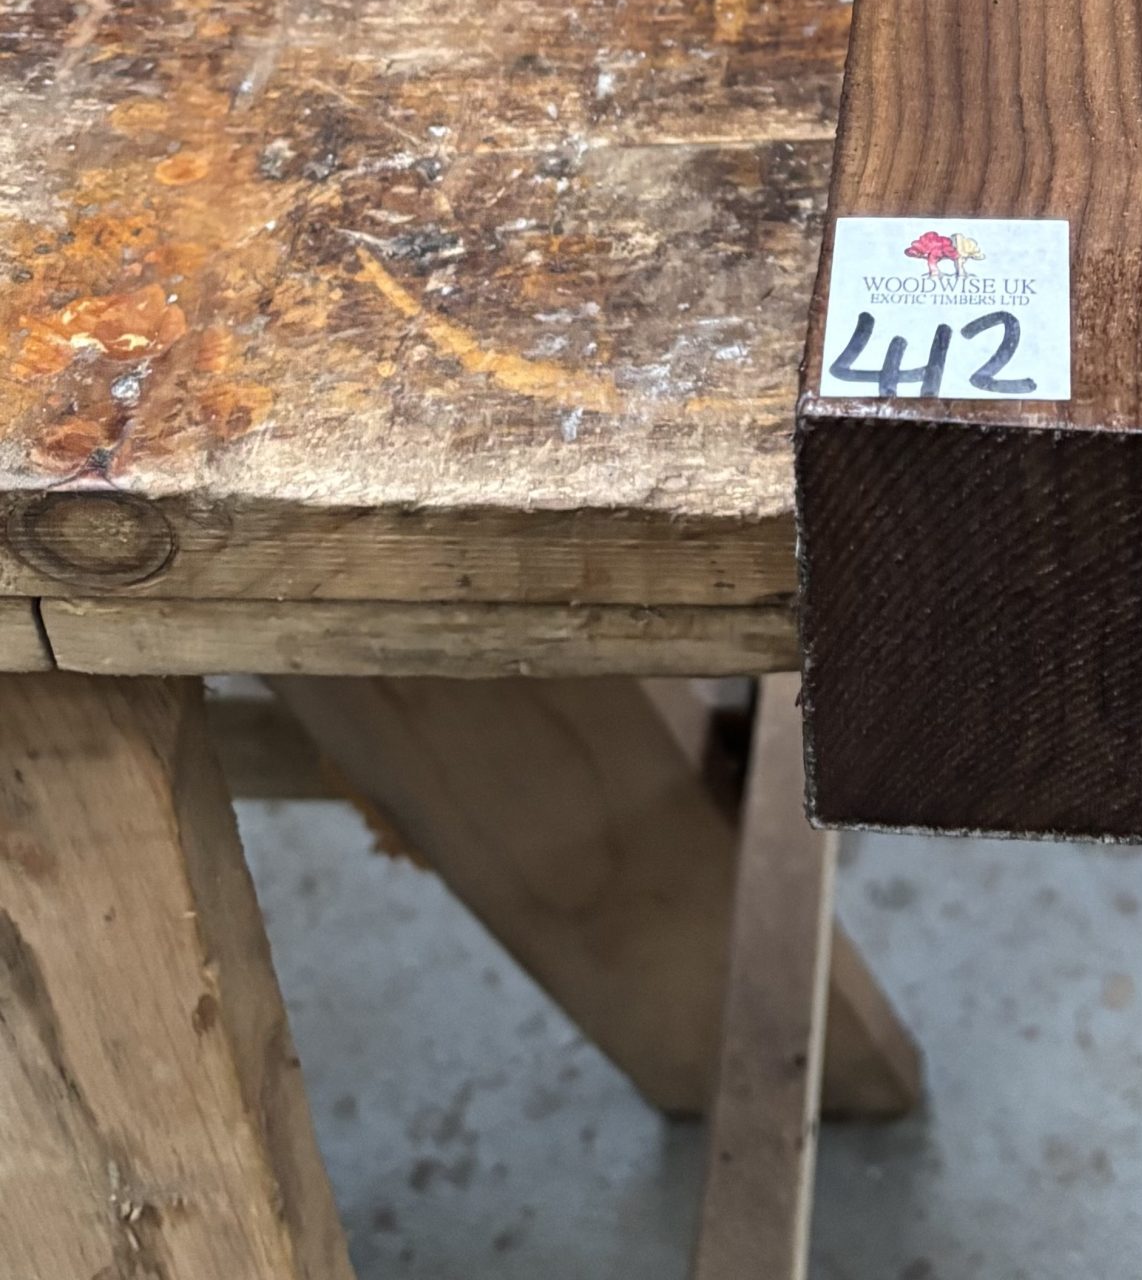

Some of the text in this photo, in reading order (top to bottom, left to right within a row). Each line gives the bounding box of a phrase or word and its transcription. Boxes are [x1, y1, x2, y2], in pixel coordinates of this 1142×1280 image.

[863, 276, 1037, 295] WOODWISE UK
[870, 293, 1030, 307] EXOTIC TIMBERS LTD
[829, 311, 1038, 397] 412
